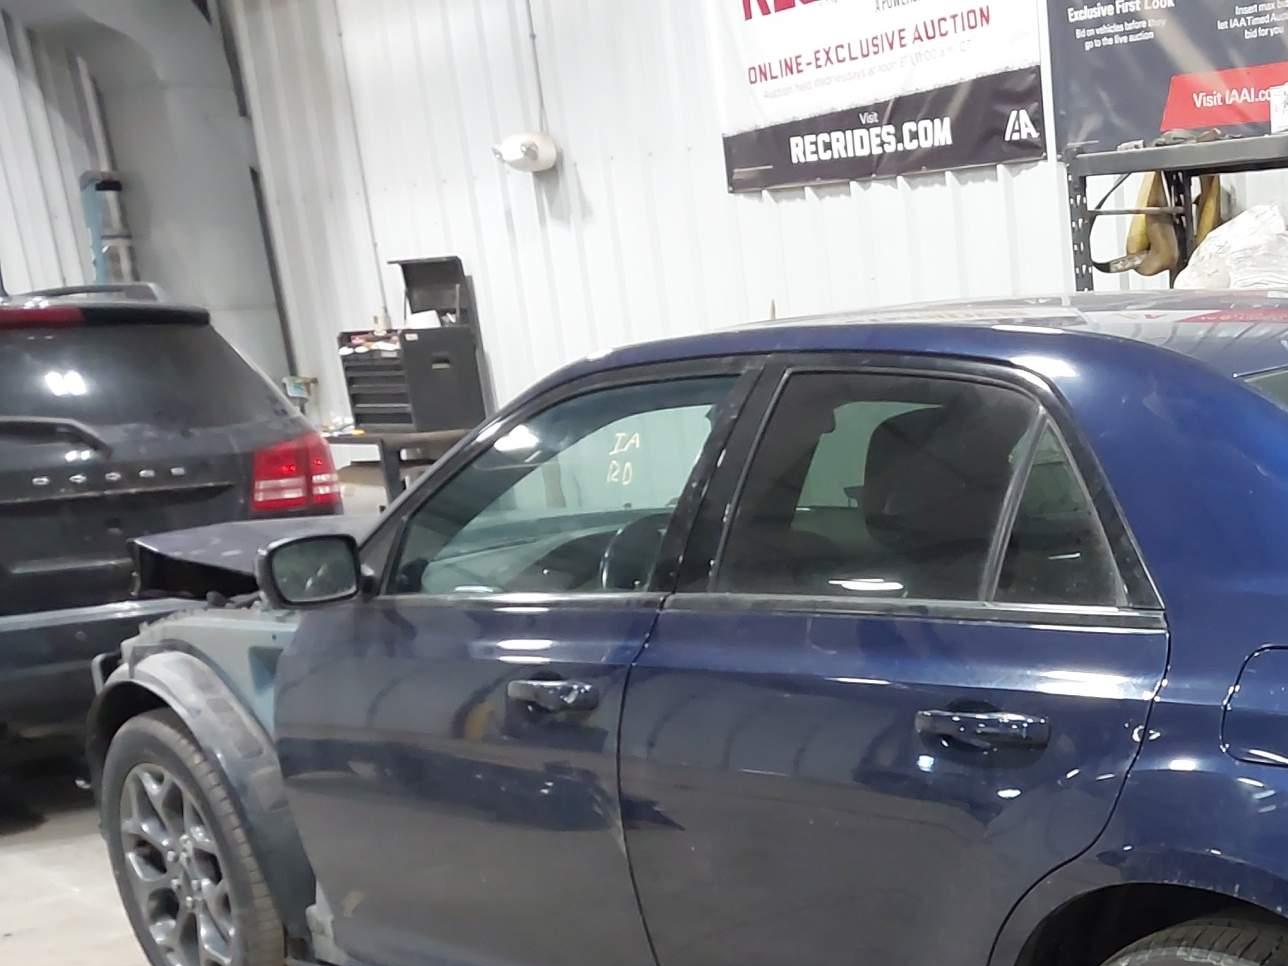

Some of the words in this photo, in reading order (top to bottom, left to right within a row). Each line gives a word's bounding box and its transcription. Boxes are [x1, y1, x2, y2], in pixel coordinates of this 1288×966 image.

[1068, 3, 1114, 22] Exclusive
[1115, 0, 1141, 14] First
[1229, 18, 1247, 28] IAA
[748, 28, 907, 85] ONLINE-EXCLUSIVE
[912, 6, 991, 44] AUCTION
[1193, 91, 1224, 108] Visit
[1225, 87, 1271, 105] IAAI.co
[859, 111, 879, 125] Visit
[790, 116, 952, 163] RECRIDES.COM
